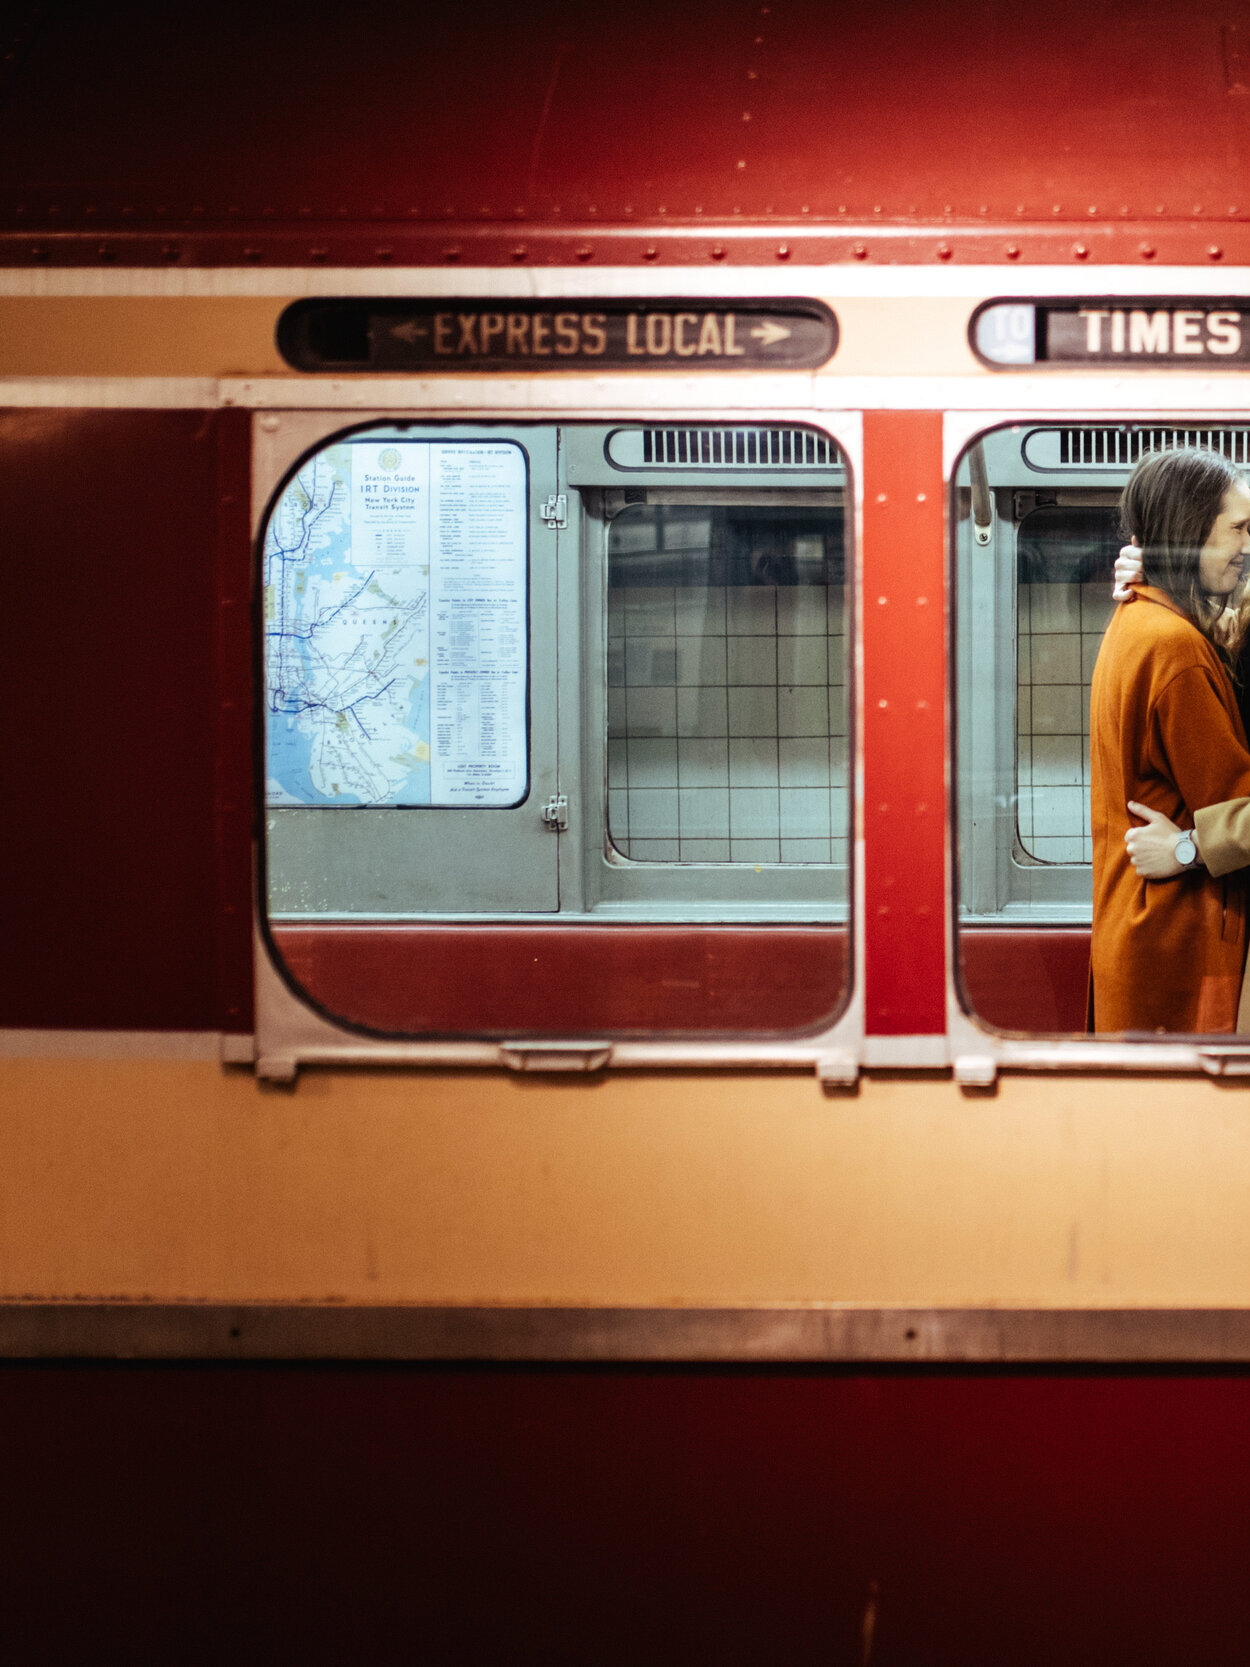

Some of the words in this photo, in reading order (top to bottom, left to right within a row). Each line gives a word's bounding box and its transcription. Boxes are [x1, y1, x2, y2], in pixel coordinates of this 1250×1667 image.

[436, 313, 607, 355] EXPRESS
[627, 313, 746, 355] LOCAL
[1079, 311, 1242, 355] TIMES
[400, 496, 415, 504] City
